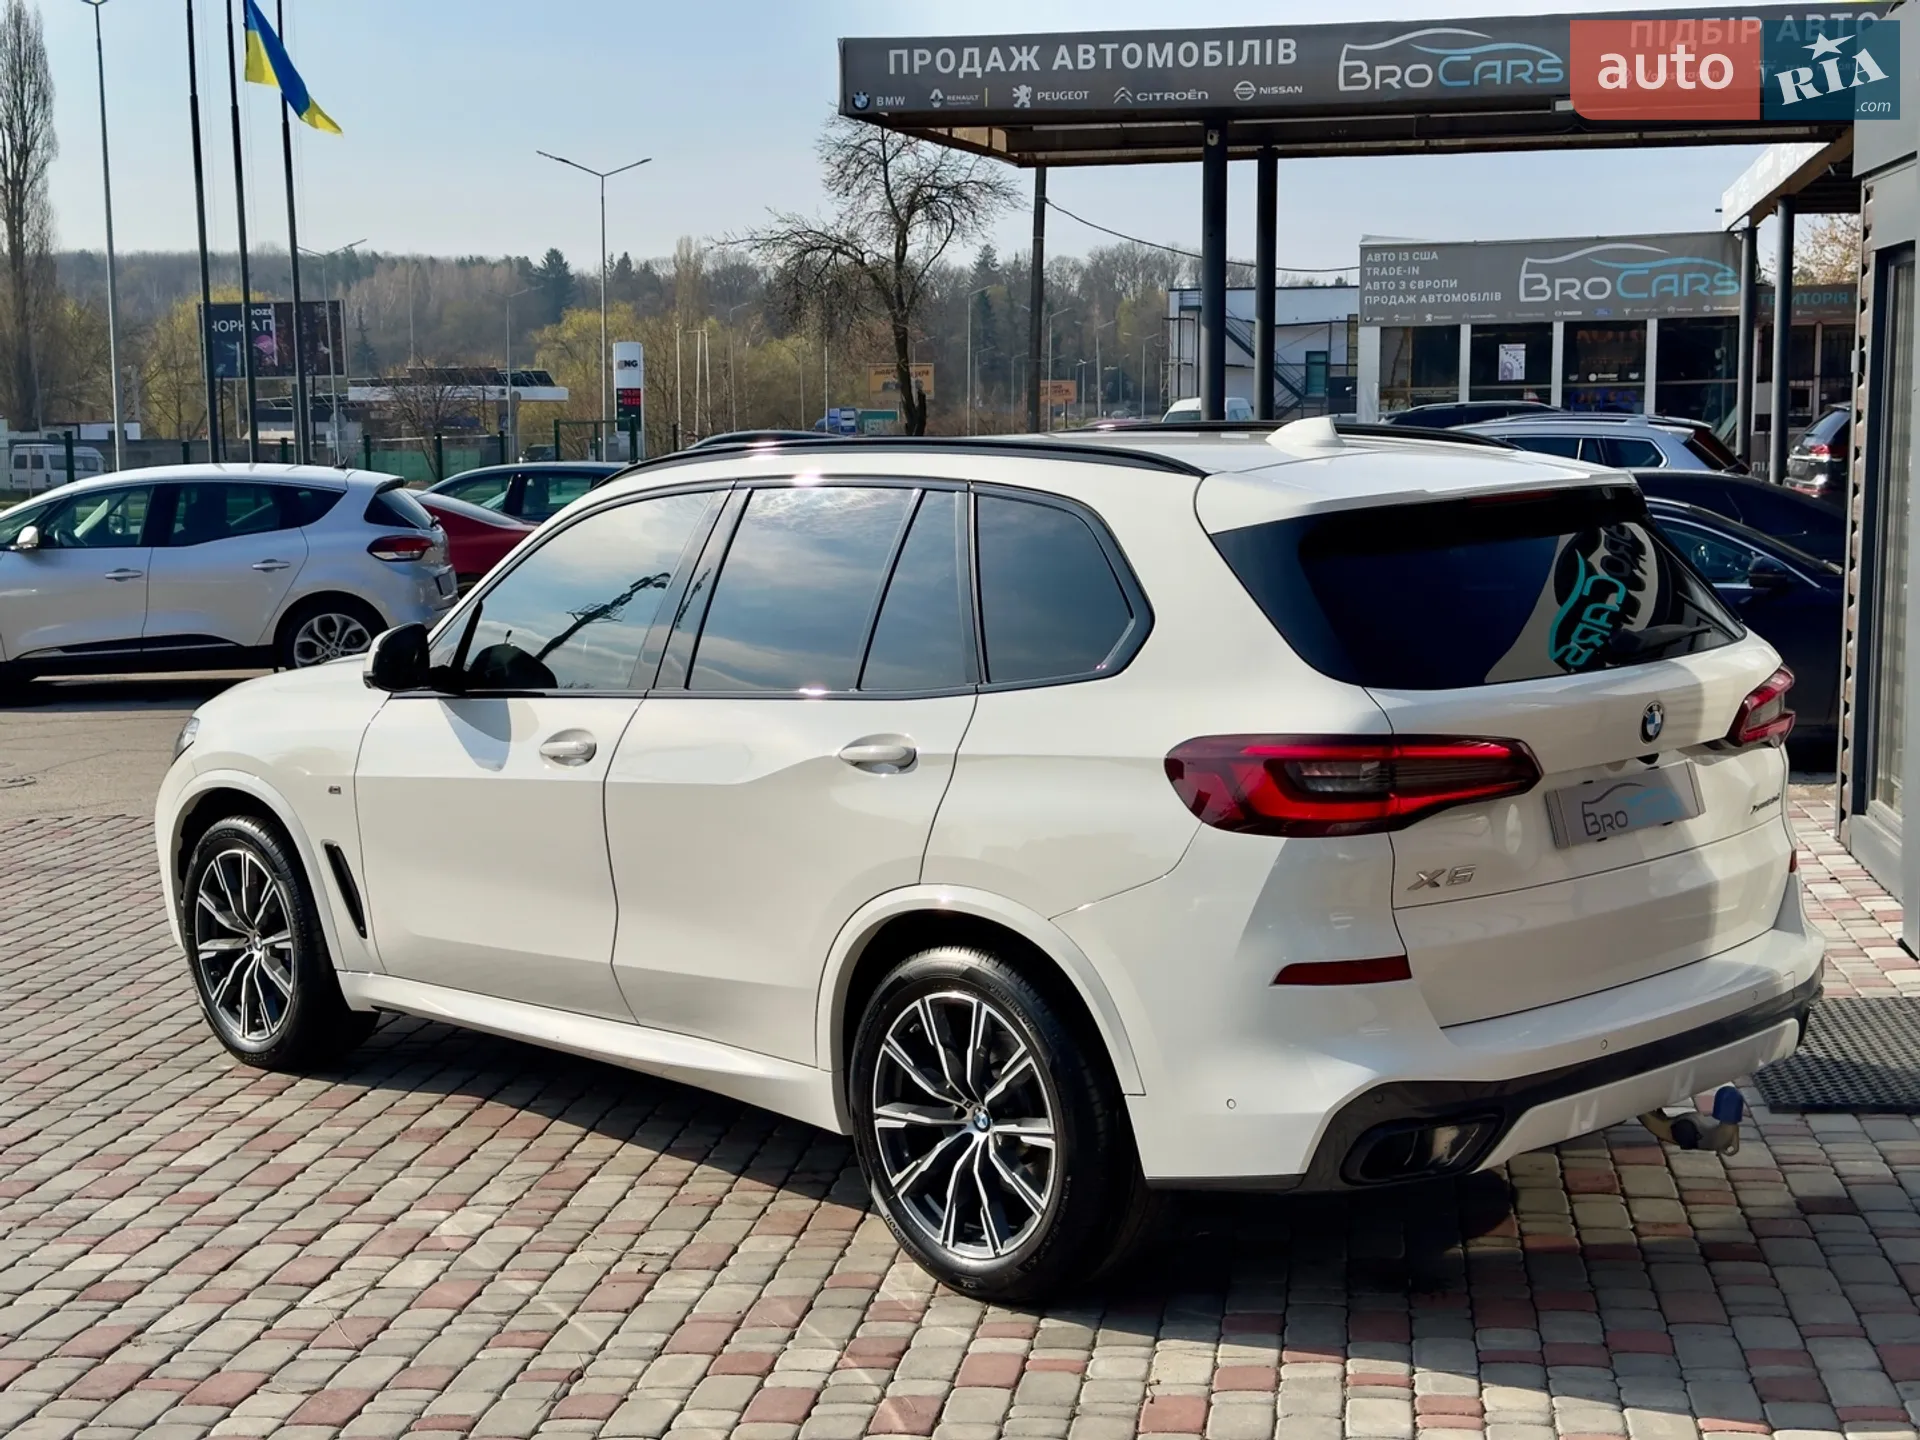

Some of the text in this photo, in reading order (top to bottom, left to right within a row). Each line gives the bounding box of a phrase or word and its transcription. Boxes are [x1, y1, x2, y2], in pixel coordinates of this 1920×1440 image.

[888, 38, 1299, 79] ПРОДАЖ АВТОМОБІЛІВ
[1037, 89, 1090, 102] PEUGEOT
[1137, 87, 1209, 102] CITROËN
[1259, 84, 1303, 96] NISSAN
[876, 95, 906, 107] BMW
[1366, 252, 1396, 263] АВТО
[1412, 251, 1439, 261] США
[1365, 266, 1420, 277] TRADE-IN
[1364, 281, 1396, 291] АВТО
[1409, 279, 1458, 290] ЄВРОПИ
[1364, 291, 1502, 306] ПРОДАЖ АВТОМОБІЛІВ
